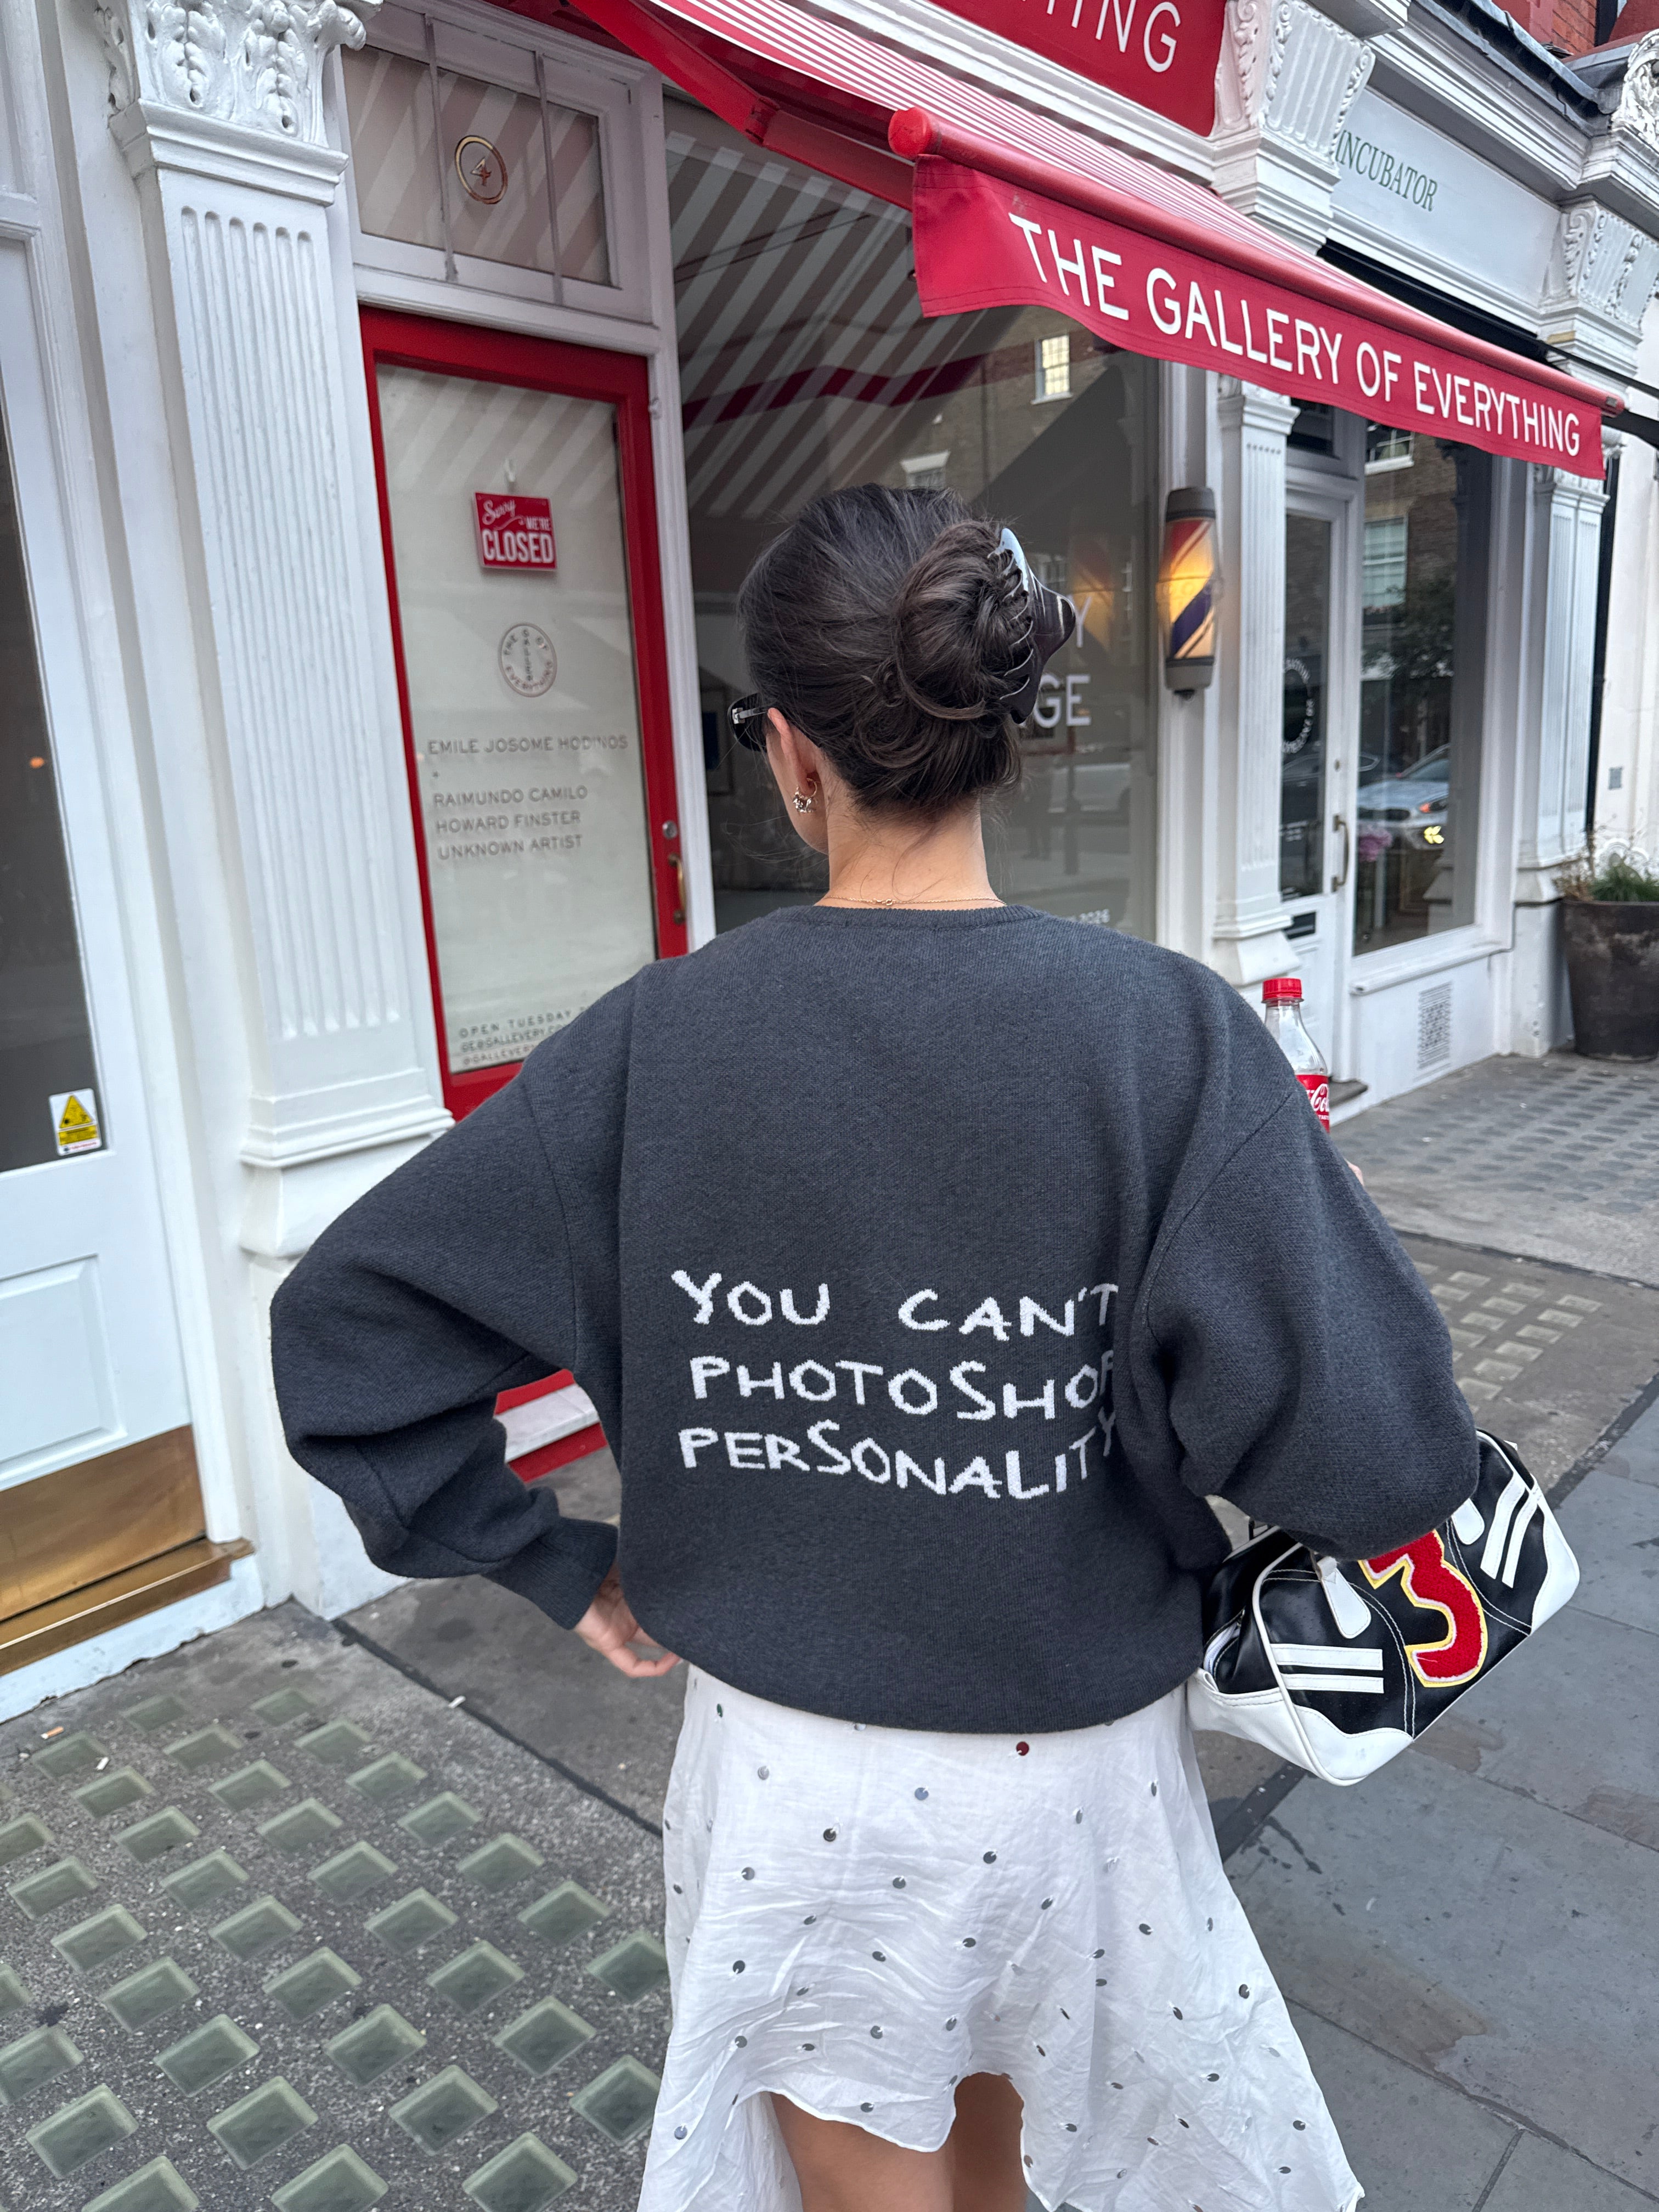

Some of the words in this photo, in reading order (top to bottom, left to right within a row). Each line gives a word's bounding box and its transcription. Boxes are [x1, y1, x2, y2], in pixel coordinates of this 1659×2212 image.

[470, 156, 492, 187] 4
[1335, 130, 1437, 212] INCUBATOR
[1008, 213, 1128, 320] THE
[1147, 268, 1342, 384] GALLERY
[1357, 342, 1401, 402] OF
[1414, 361, 1579, 456] EVERYTHING
[482, 499, 516, 525] Sorry
[482, 528, 554, 563] CLOSED
[1034, 674, 1091, 727] GE
[428, 738, 479, 755] EMILE
[483, 737, 554, 754] JOSOME
[433, 788, 524, 808] RAIMUNDO
[528, 785, 588, 803] CAMILO
[436, 815, 509, 833] HOWARD
[514, 810, 580, 827] FINSTER
[439, 839, 524, 860] UNKNOWN
[530, 834, 583, 851] ARTIST
[459, 1023, 500, 1039] OPEN
[506, 1010, 571, 1029] TUESDAY
[671, 1270, 830, 1325] YOU
[898, 1283, 1119, 1342] CAN'T
[690, 1350, 1115, 1421] PHOTOSHOP
[678, 1407, 1116, 1499] PERSONALITY
[1357, 1528, 1488, 1688] 3
